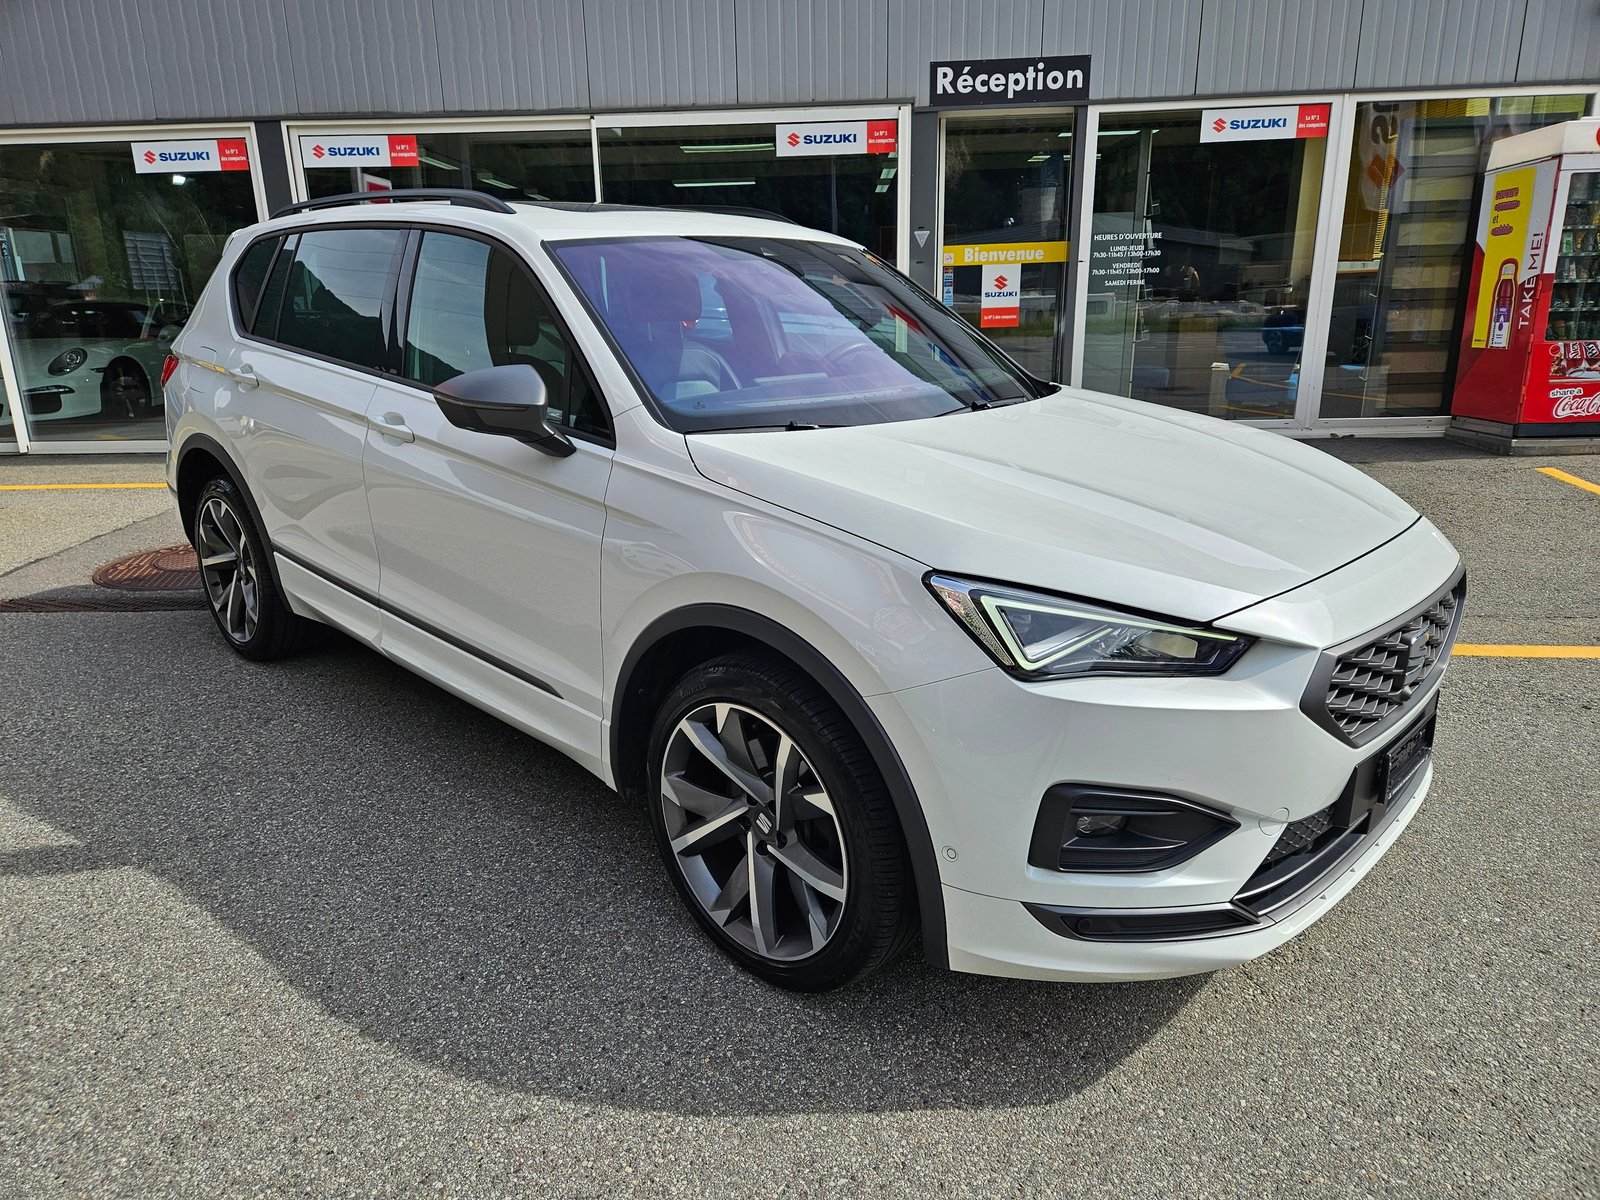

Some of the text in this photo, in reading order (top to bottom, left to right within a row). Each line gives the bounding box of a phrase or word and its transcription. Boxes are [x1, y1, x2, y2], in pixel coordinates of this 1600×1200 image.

[936, 62, 1083, 99] Réception
[1229, 118, 1287, 130] SUZUKI
[803, 133, 857, 144] SUZUKI
[159, 151, 210, 161] SUZUKI
[328, 147, 380, 156] SUZUKI
[1119, 232, 1162, 240] D'OUVERTURE
[964, 247, 1045, 263] Bienvenue
[1519, 232, 1544, 330] TAKE ME!
[1551, 389, 1575, 397] share
[1554, 392, 1600, 418] Coca-C
